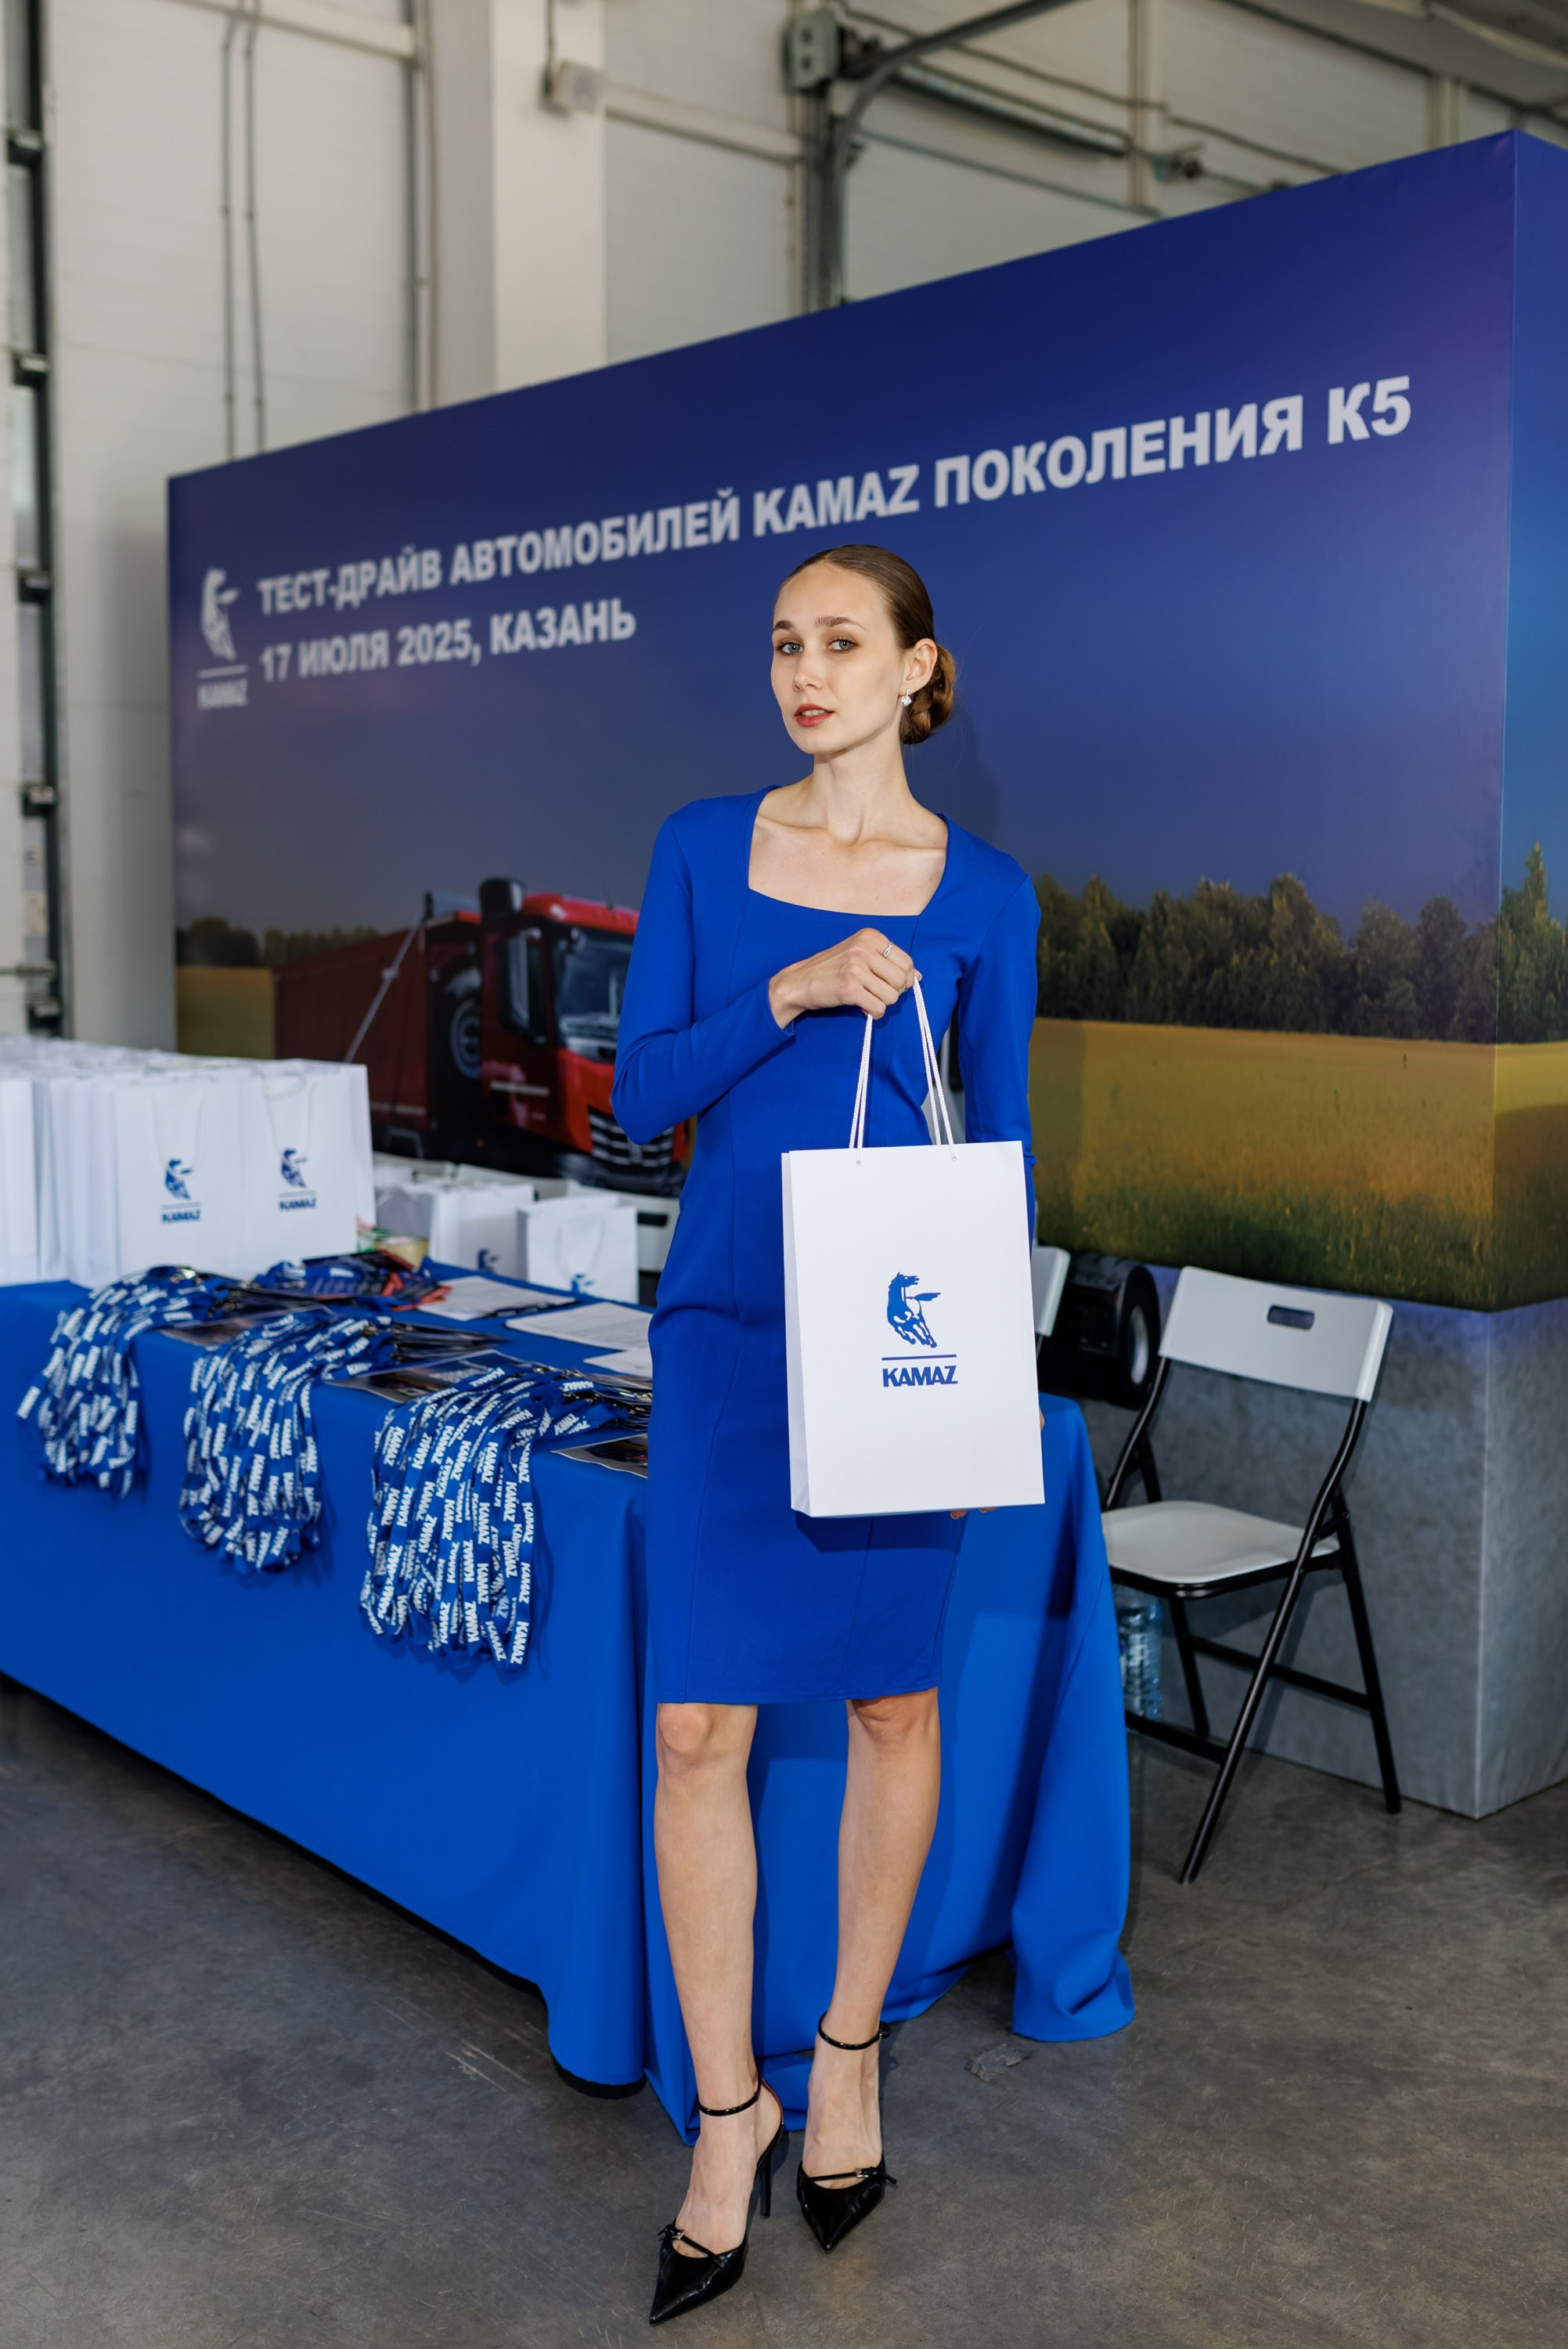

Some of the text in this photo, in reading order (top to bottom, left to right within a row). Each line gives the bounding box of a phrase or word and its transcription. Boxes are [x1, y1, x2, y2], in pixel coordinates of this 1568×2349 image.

[258, 547, 442, 615] ТЕСТ-ДРАЙВ
[449, 488, 740, 586] АВТОМОБИЛЕЙ
[753, 464, 920, 537] KAMAZ
[935, 395, 1303, 507] ПОКОЛЕНИЯ
[260, 598, 636, 682] 17 ИЮЛЯ 2025, КАЗАНЬ
[562, 1380, 594, 1392] KAMAZ
[882, 1366, 958, 1387] KAMAZ
[384, 1426, 406, 1467] KAMAZ
[412, 1431, 433, 1470] KAMAZ
[431, 1425, 455, 1465] KAMAZ
[449, 1440, 472, 1481] KAMAZ
[481, 1442, 499, 1484] KAMAZ
[396, 1485, 414, 1528] KAMAZ
[415, 1481, 435, 1521] KAMAZ
[442, 1499, 456, 1542] KAMAZ
[503, 1481, 517, 1523] KAMAZ
[417, 1514, 438, 1553] KAMAZ
[478, 1502, 490, 1545] KAMAZ
[521, 1502, 535, 1544] KAMAZ
[446, 1541, 460, 1584] KAMAZ
[463, 1539, 475, 1582] KAMAZ
[502, 1540, 517, 1579] KAMAZ
[477, 1562, 489, 1604] KAMAZ
[519, 1561, 531, 1604] KAMAZ
[439, 1601, 451, 1644] KAMAZ
[464, 1600, 480, 1643] KAMAZ
[485, 1621, 507, 1662] KAMAZ
[510, 1621, 529, 1665] KAMAZ
